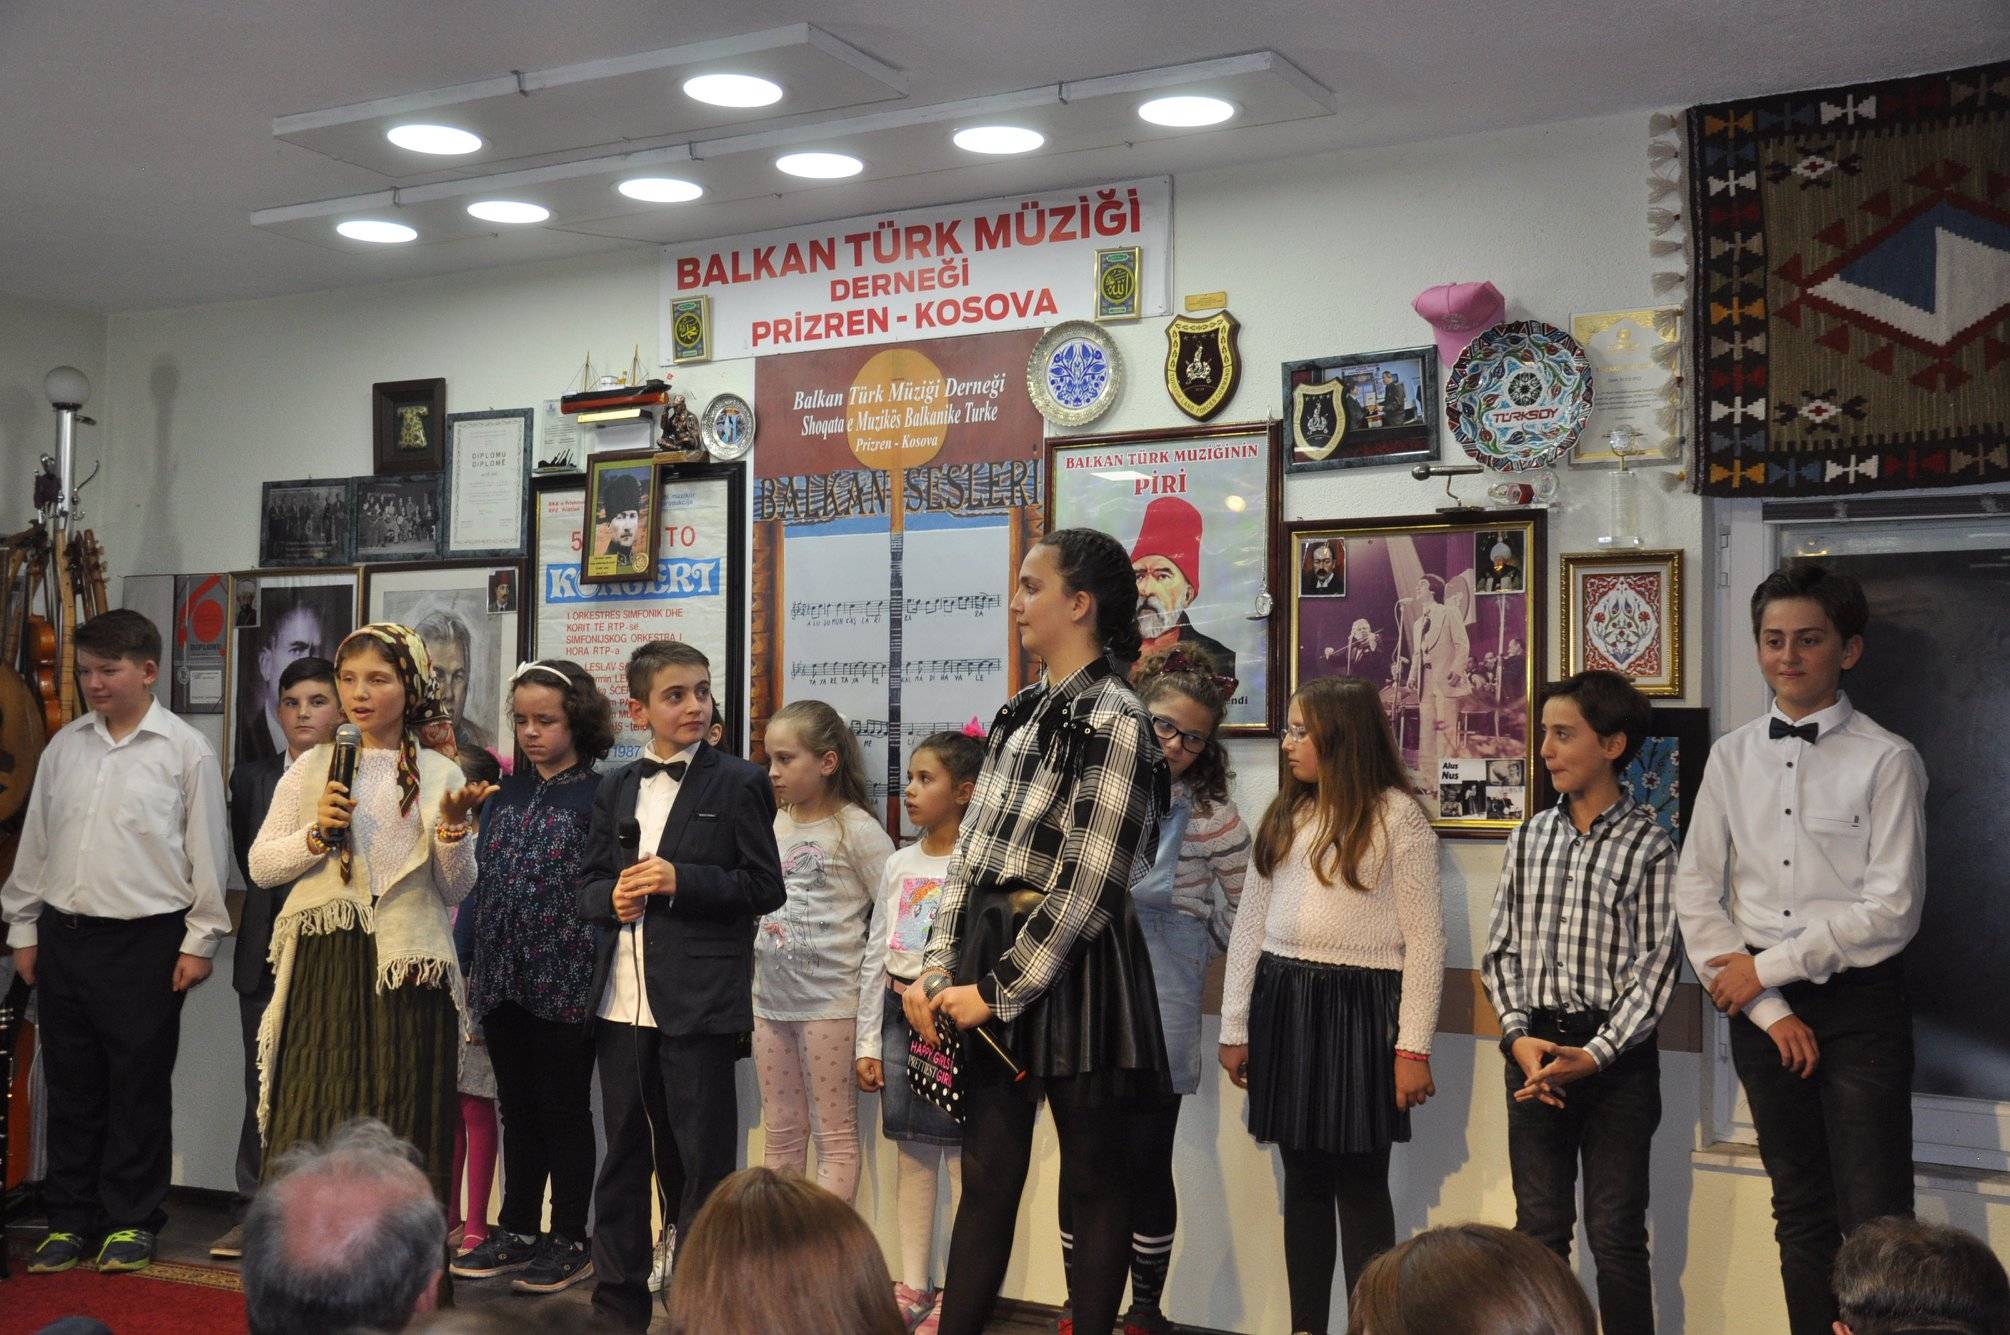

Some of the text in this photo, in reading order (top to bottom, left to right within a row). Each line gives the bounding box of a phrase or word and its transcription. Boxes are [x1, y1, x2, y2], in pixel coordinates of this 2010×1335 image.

[677, 188, 1141, 291] BALKAN TÜRK MÜZİĞİ
[830, 257, 970, 302] DERNEĞİ
[751, 305, 890, 348] PRİZREN
[915, 287, 1059, 329] KOSOVA
[793, 372, 1007, 410] Balkan Türk Müziği Derneği
[801, 400, 998, 440] Shoqata e Muzikës Balkanike Turke
[855, 437, 892, 452] Prizren
[902, 434, 938, 448] Kosova
[1065, 454, 1123, 469] BALKAN
[1128, 449, 1169, 466] TÜRK
[761, 470, 891, 521] BALKAN
[623, 608, 663, 619] SIMFONIK
[665, 608, 683, 618] DHE
[614, 744, 641, 758] 1987
[911, 1041, 932, 1060] HAPPY
